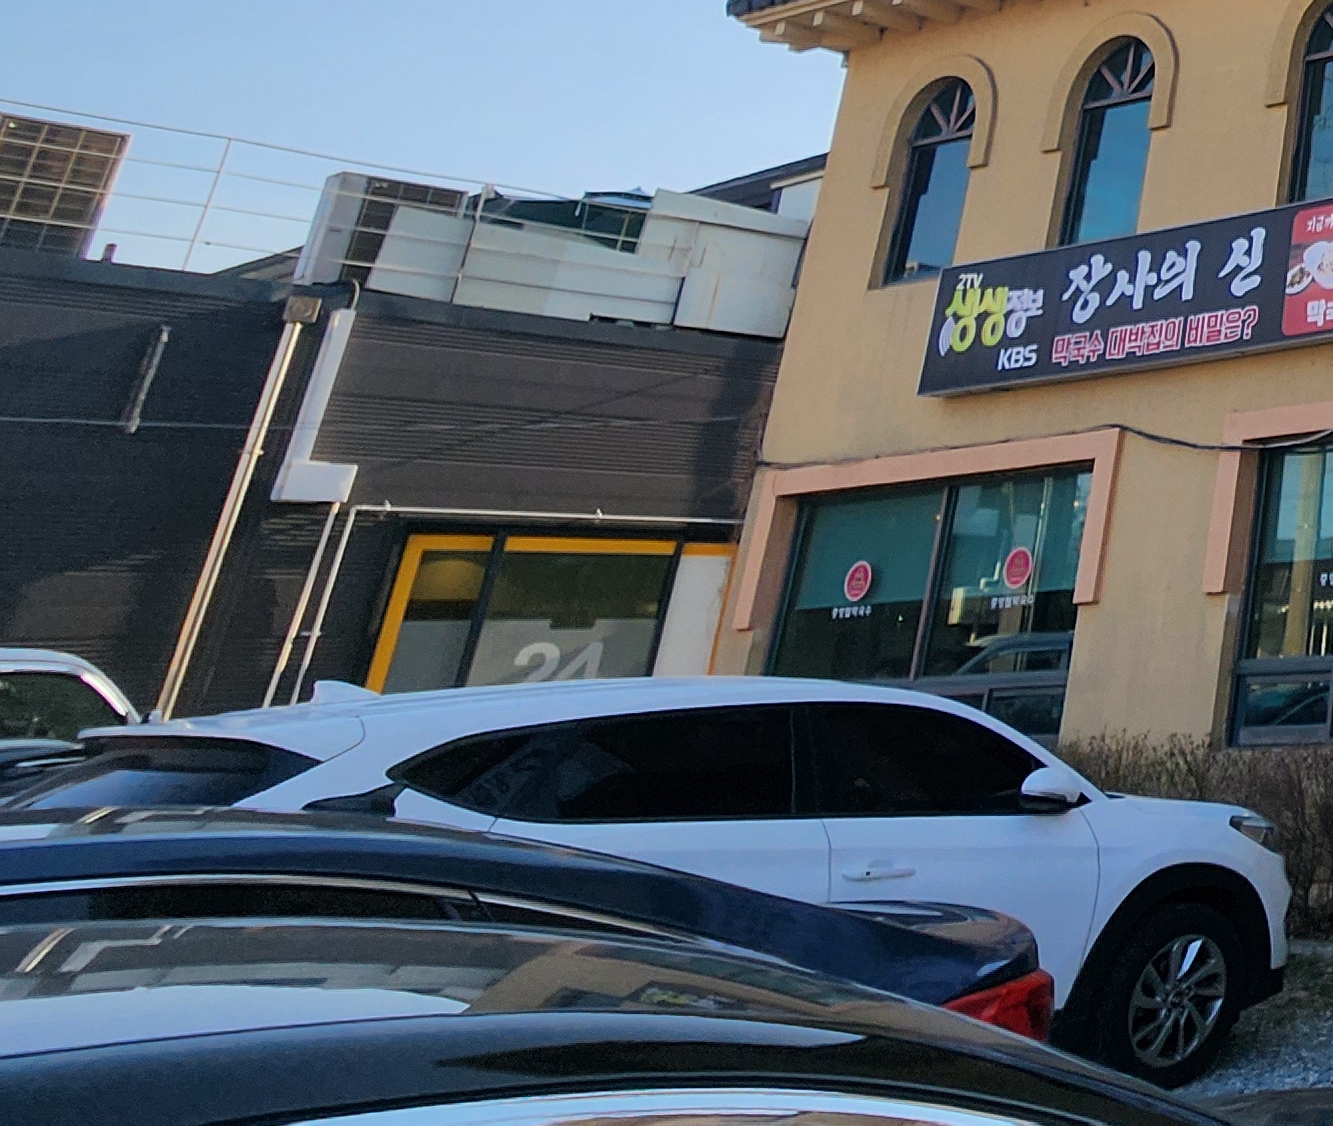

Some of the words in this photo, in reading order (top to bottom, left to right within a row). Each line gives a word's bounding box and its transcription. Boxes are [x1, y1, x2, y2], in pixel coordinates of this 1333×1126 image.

[957, 273, 983, 290] 2TV
[1062, 240, 1201, 323] 장사의
[1218, 227, 1266, 296] 신
[1052, 330, 1104, 366] 막국수
[1106, 317, 1184, 360] 대박집의
[1185, 305, 1259, 347] 비밀은?
[997, 345, 1038, 370] KBS
